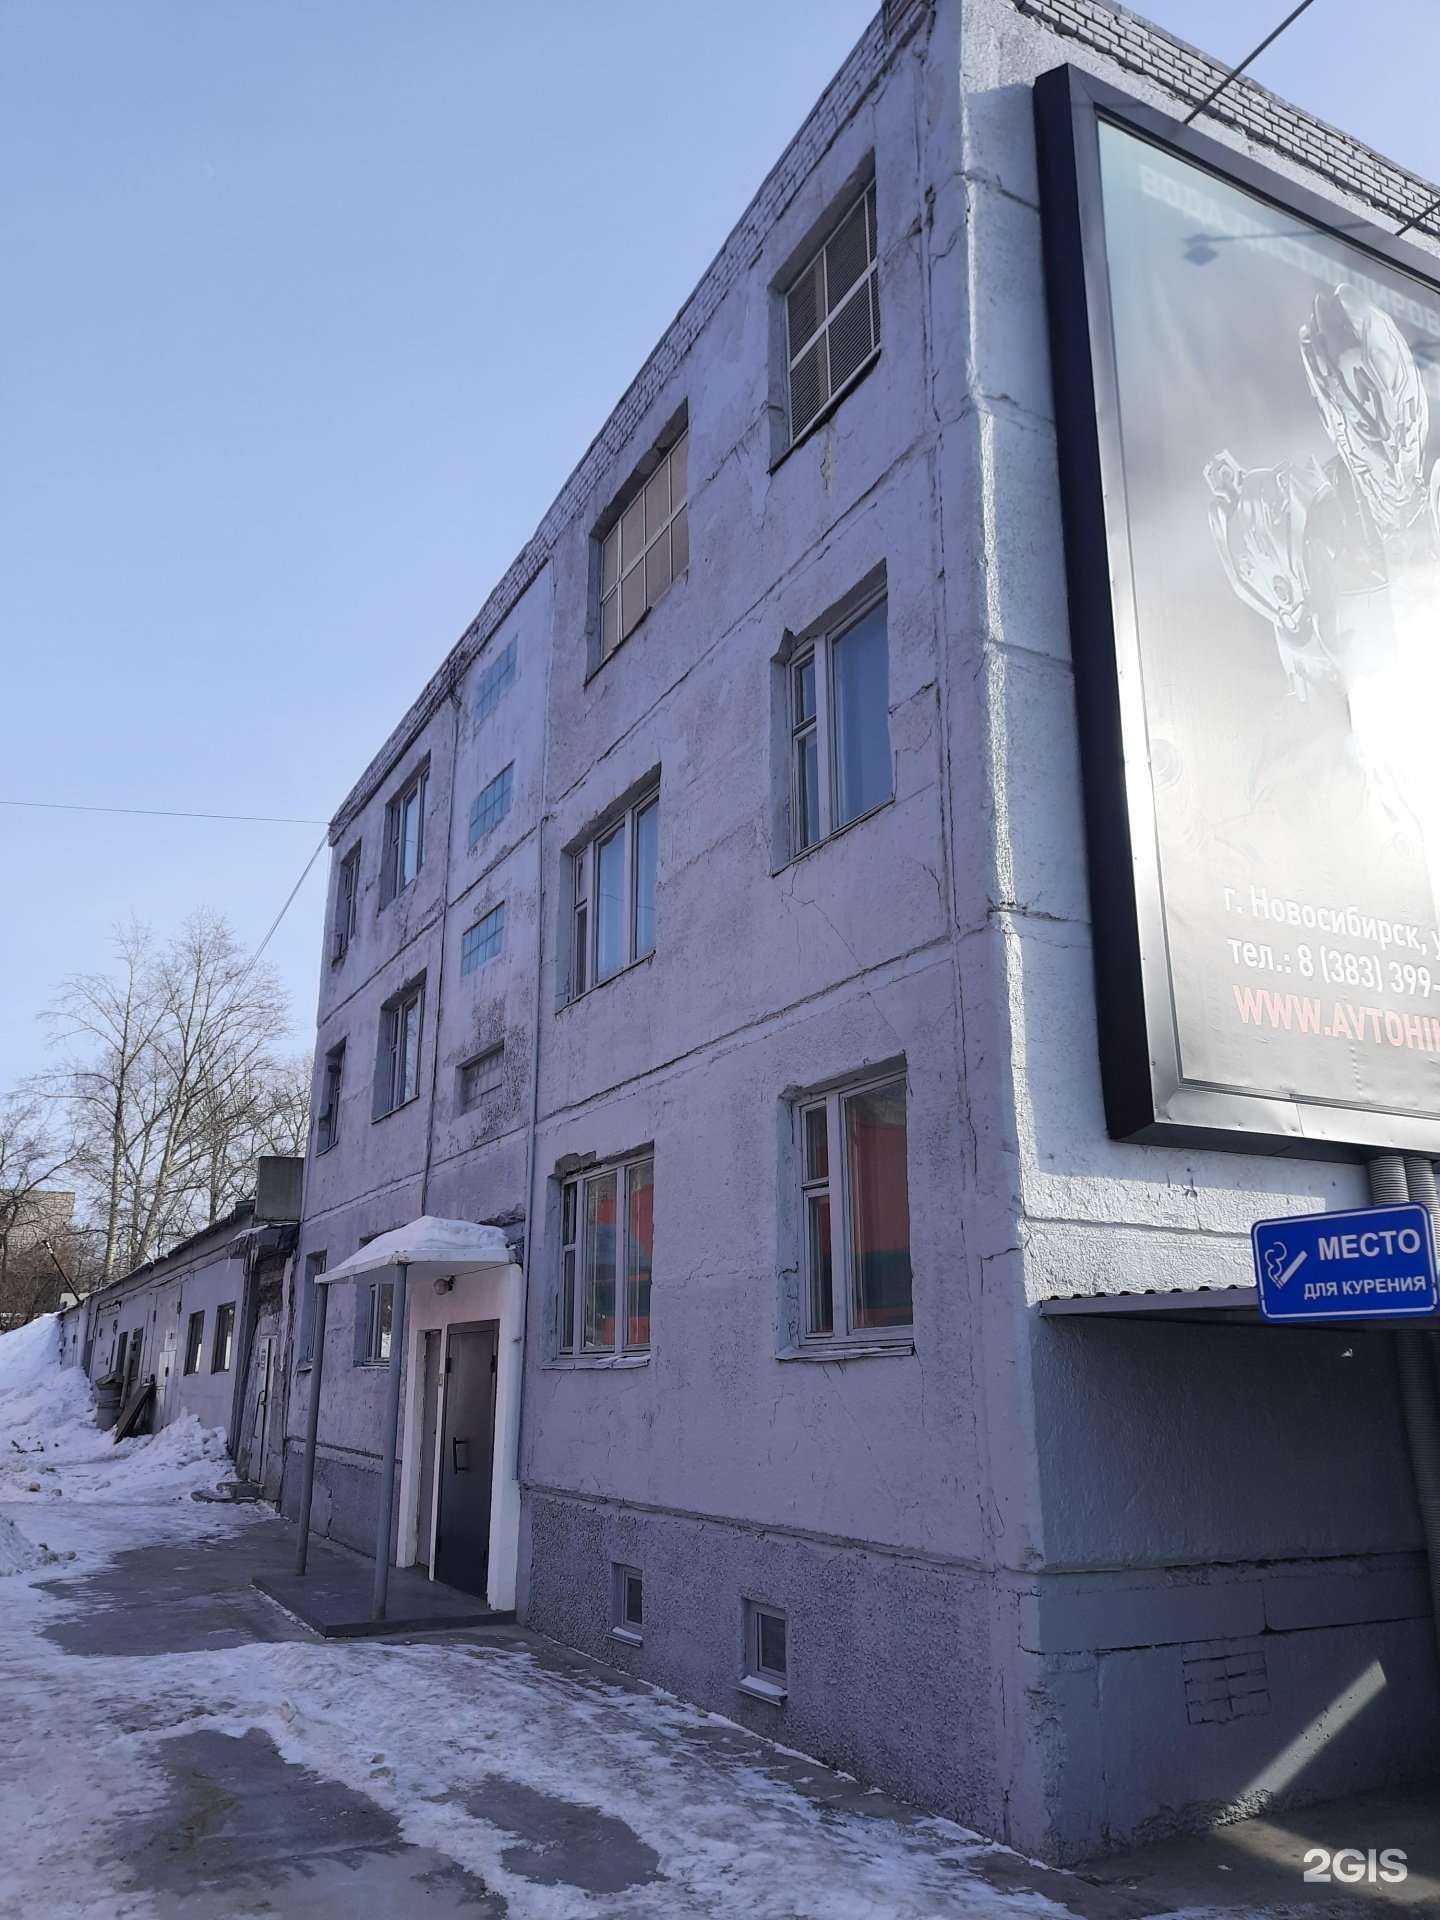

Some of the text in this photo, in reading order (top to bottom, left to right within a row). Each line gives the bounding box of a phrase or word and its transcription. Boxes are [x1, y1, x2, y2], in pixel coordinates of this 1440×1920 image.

[1223, 886, 1244, 914] г.
[1250, 884, 1427, 956] Новосибирск,
[1226, 937, 1292, 974] тел.:
[1297, 944, 1314, 977] 8
[1320, 945, 1383, 992] (383)
[1318, 1228, 1421, 1261] МЕСТО
[1304, 1275, 1427, 1300] ДЛЯ КУРЕНИЯ
